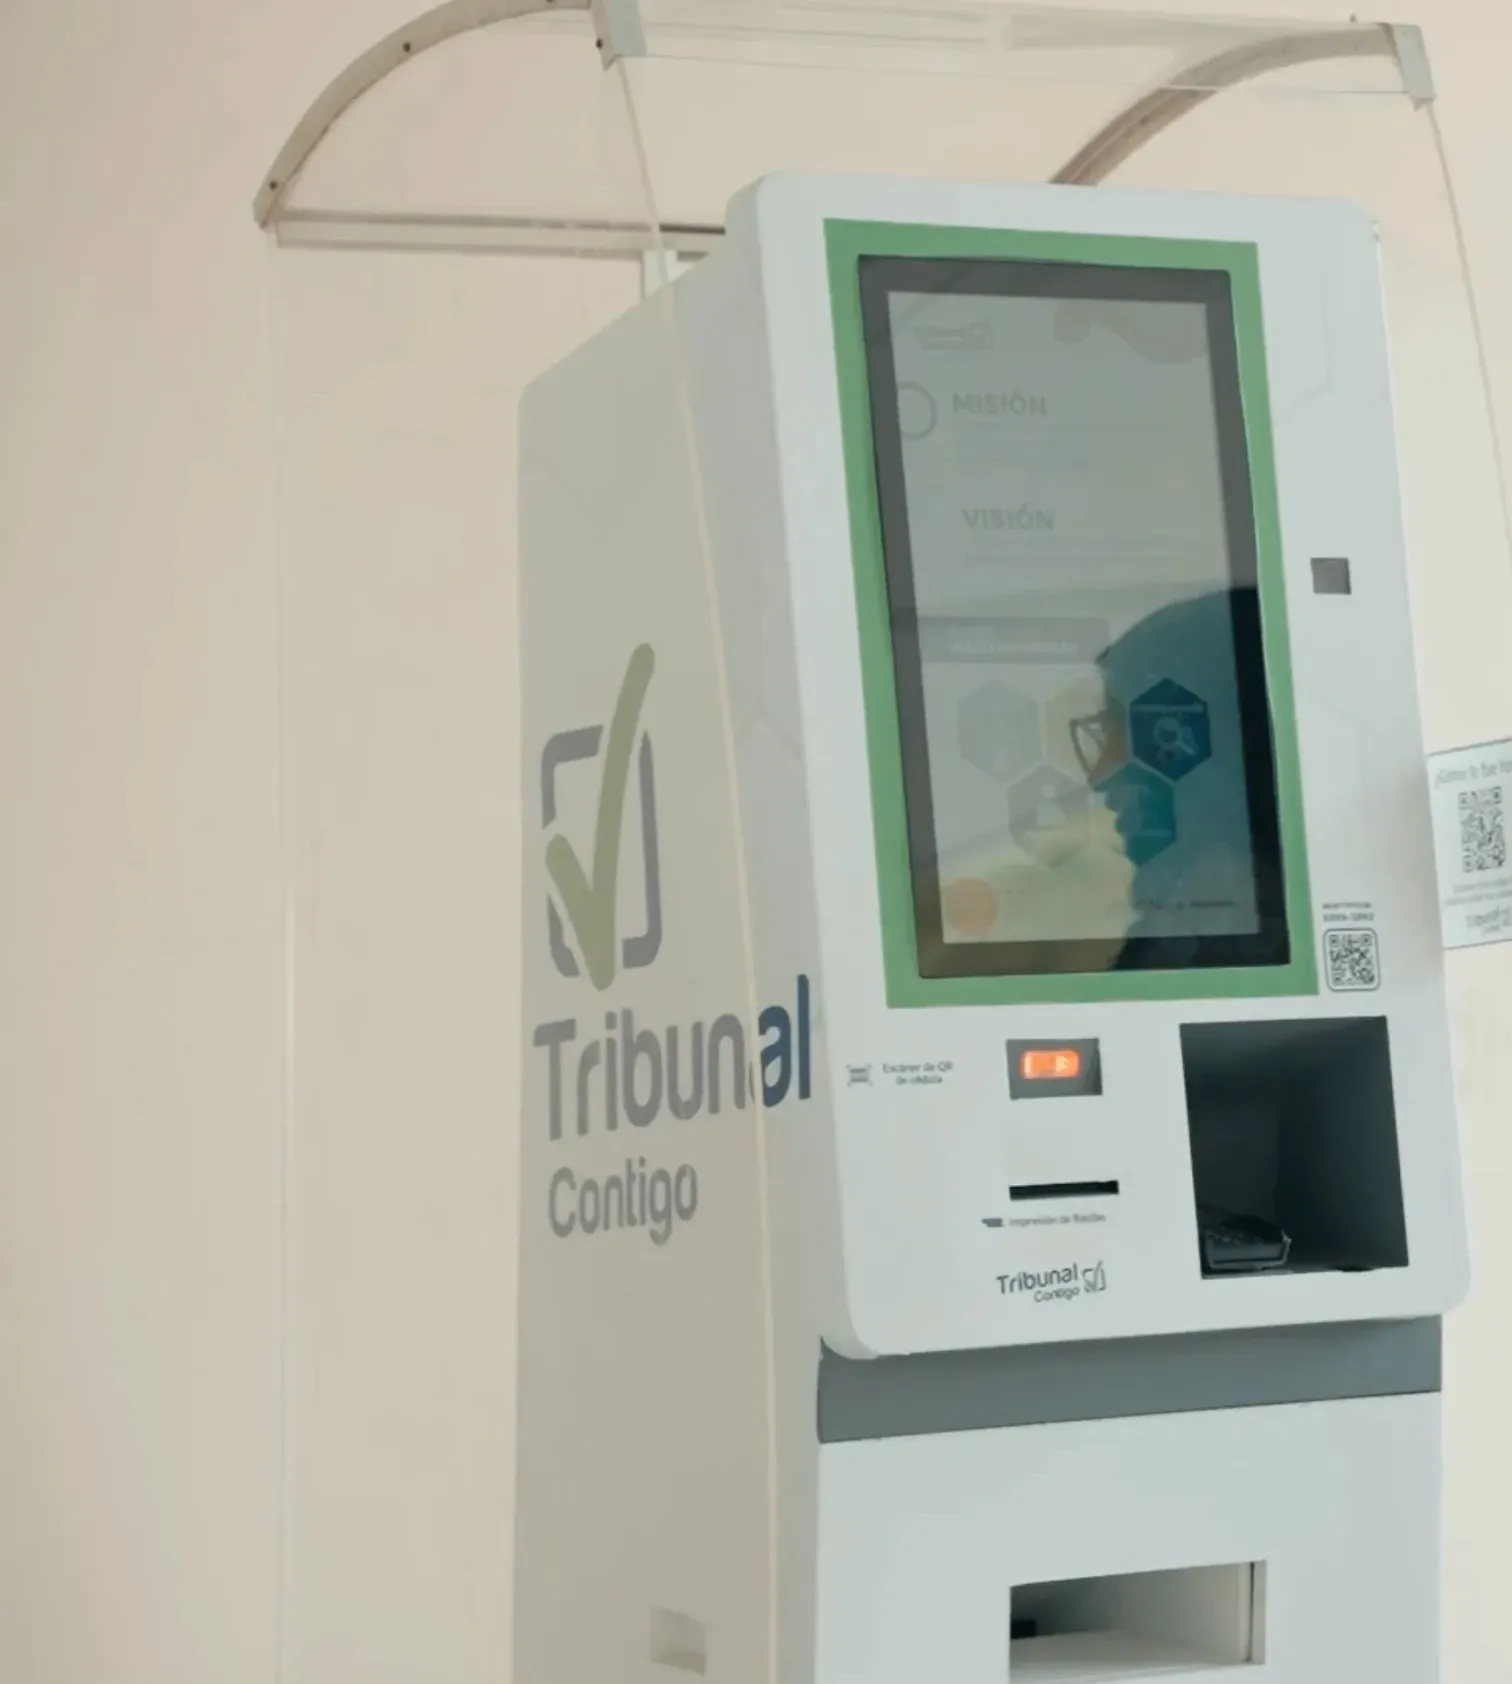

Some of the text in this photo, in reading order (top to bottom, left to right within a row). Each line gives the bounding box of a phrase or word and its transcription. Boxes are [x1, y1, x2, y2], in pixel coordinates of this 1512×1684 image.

[952, 389, 1047, 416] MISIÓN
[962, 503, 1055, 531] VISIÓN
[533, 974, 811, 1141] Tribunal
[937, 1060, 954, 1073] QR
[548, 1156, 699, 1246] Contigo
[996, 1261, 1078, 1294] Tribunal
